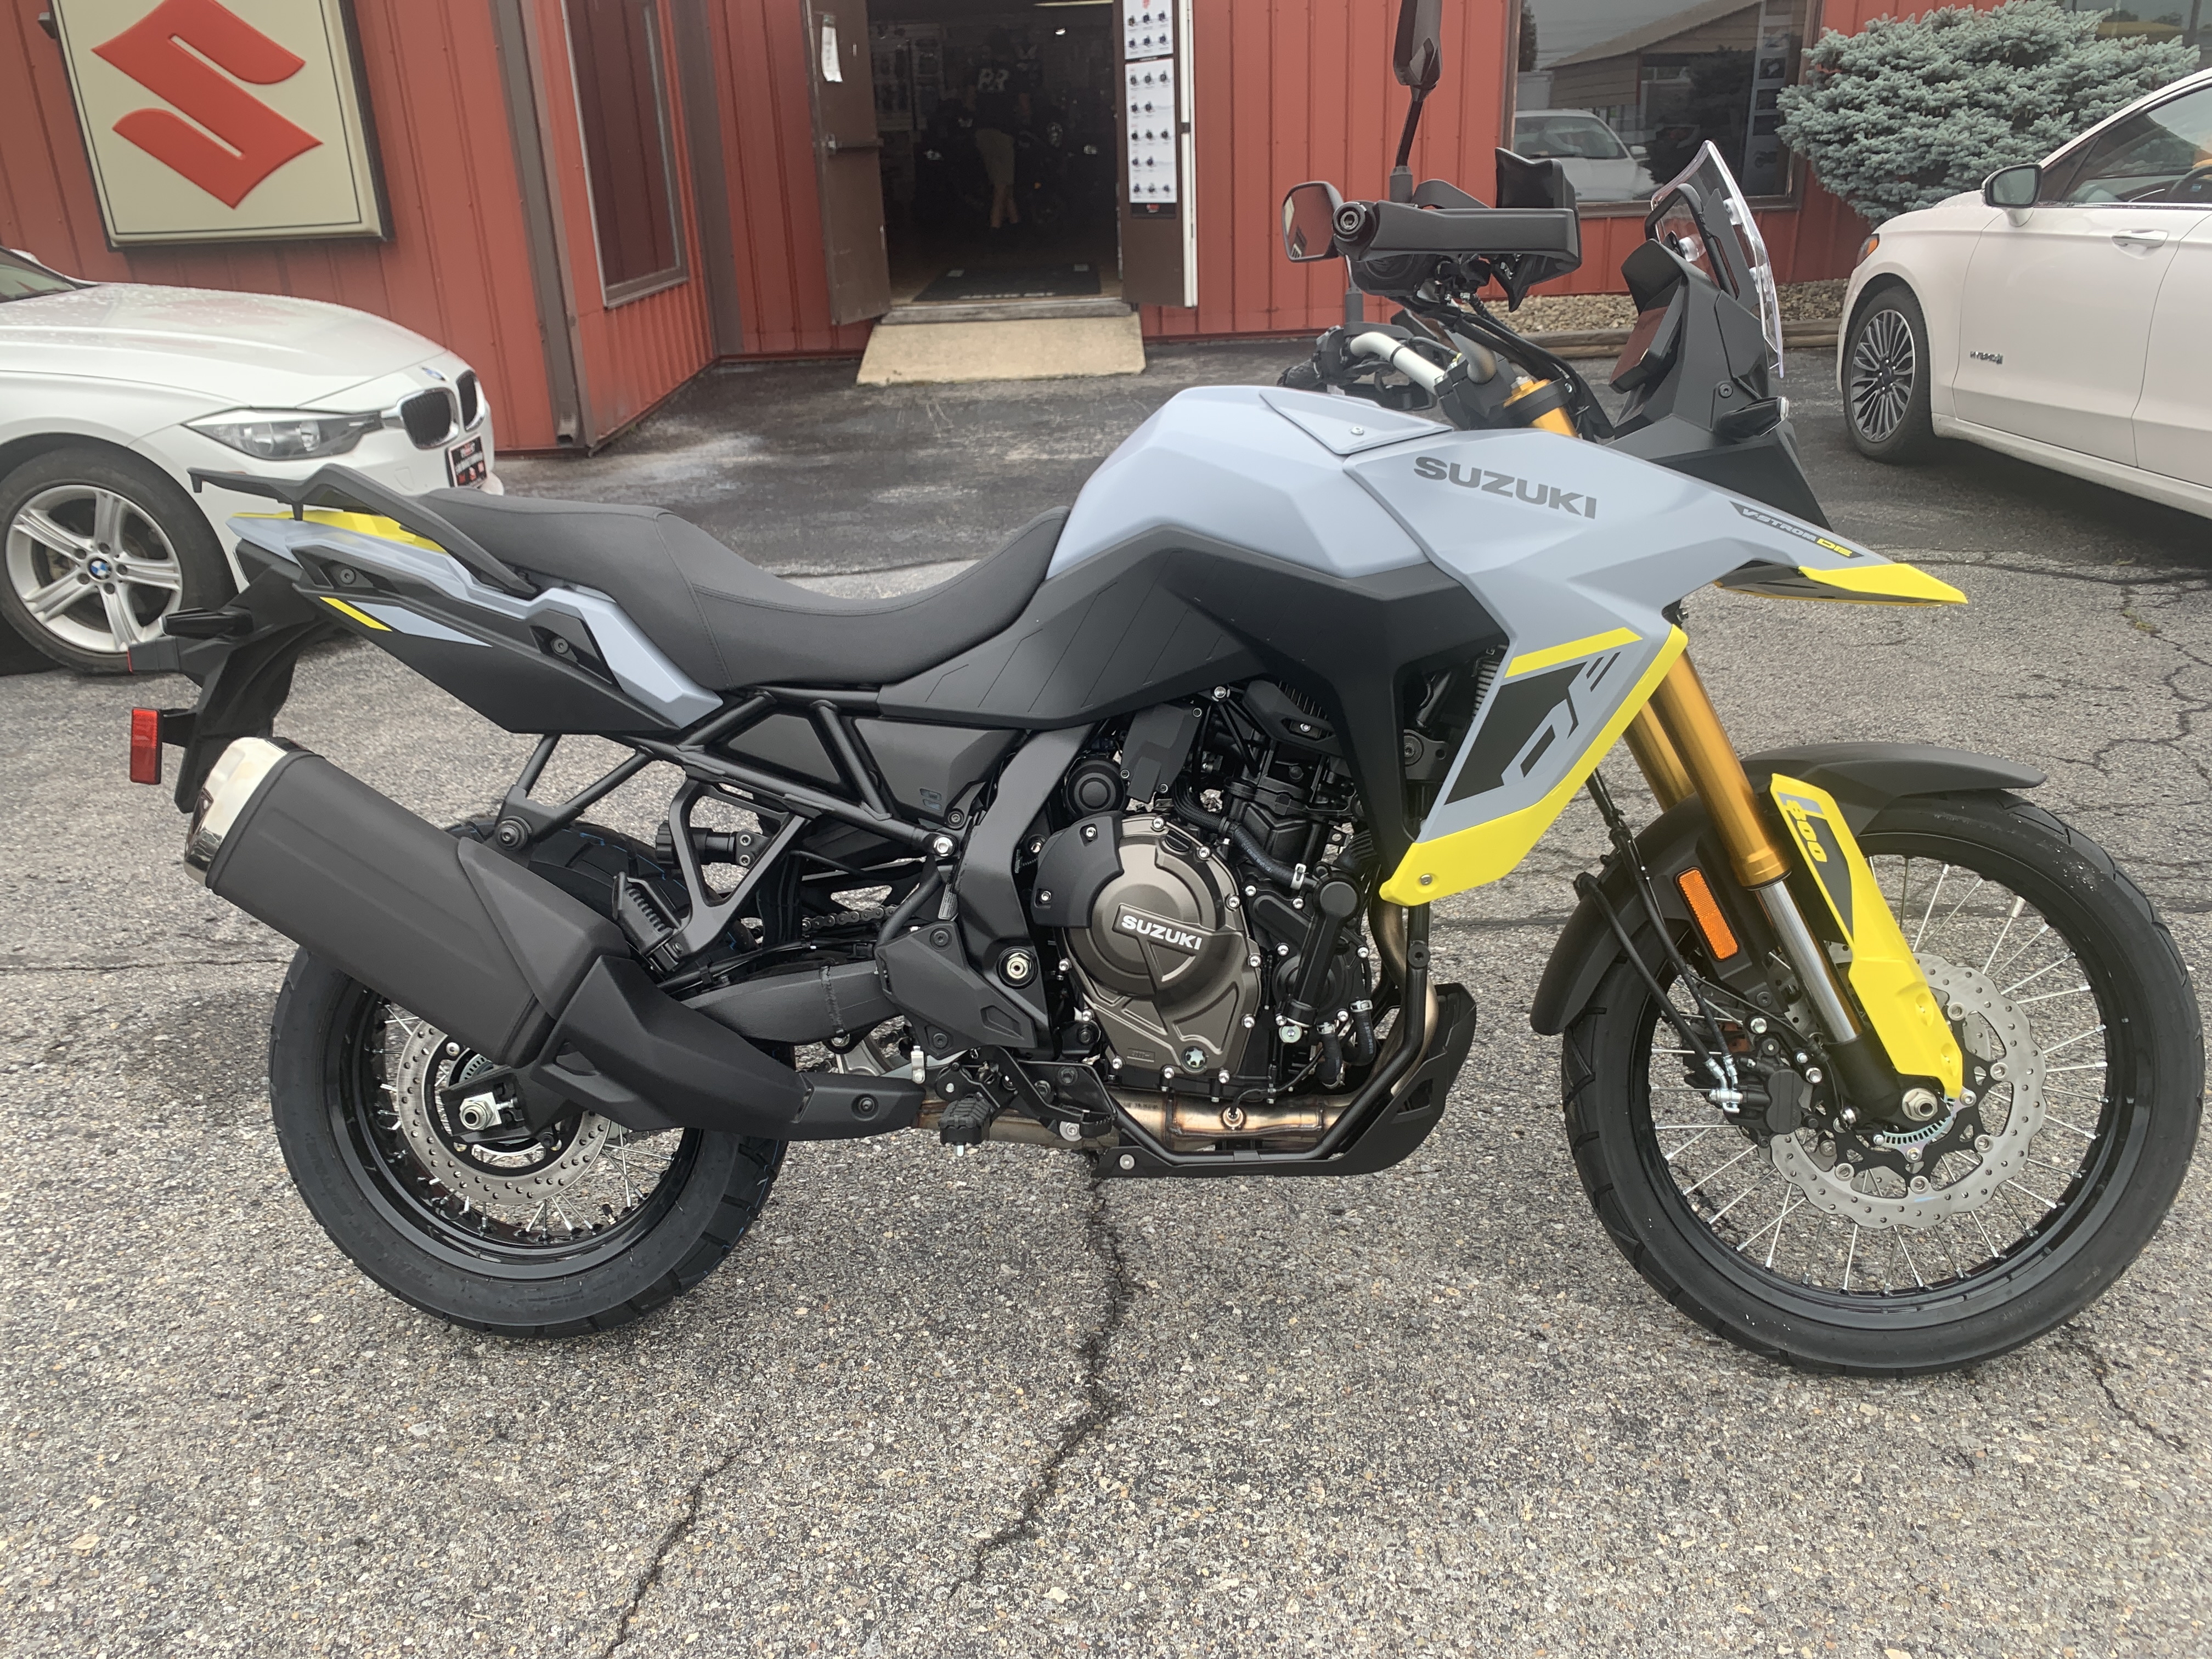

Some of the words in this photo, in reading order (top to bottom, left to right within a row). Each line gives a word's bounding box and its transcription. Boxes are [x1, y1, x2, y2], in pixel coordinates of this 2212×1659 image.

[1413, 456, 1597, 520] SUZUKI
[1816, 538, 1853, 557] DE
[1786, 799, 1827, 862] 800
[1121, 915, 1203, 950] SUZUKI
